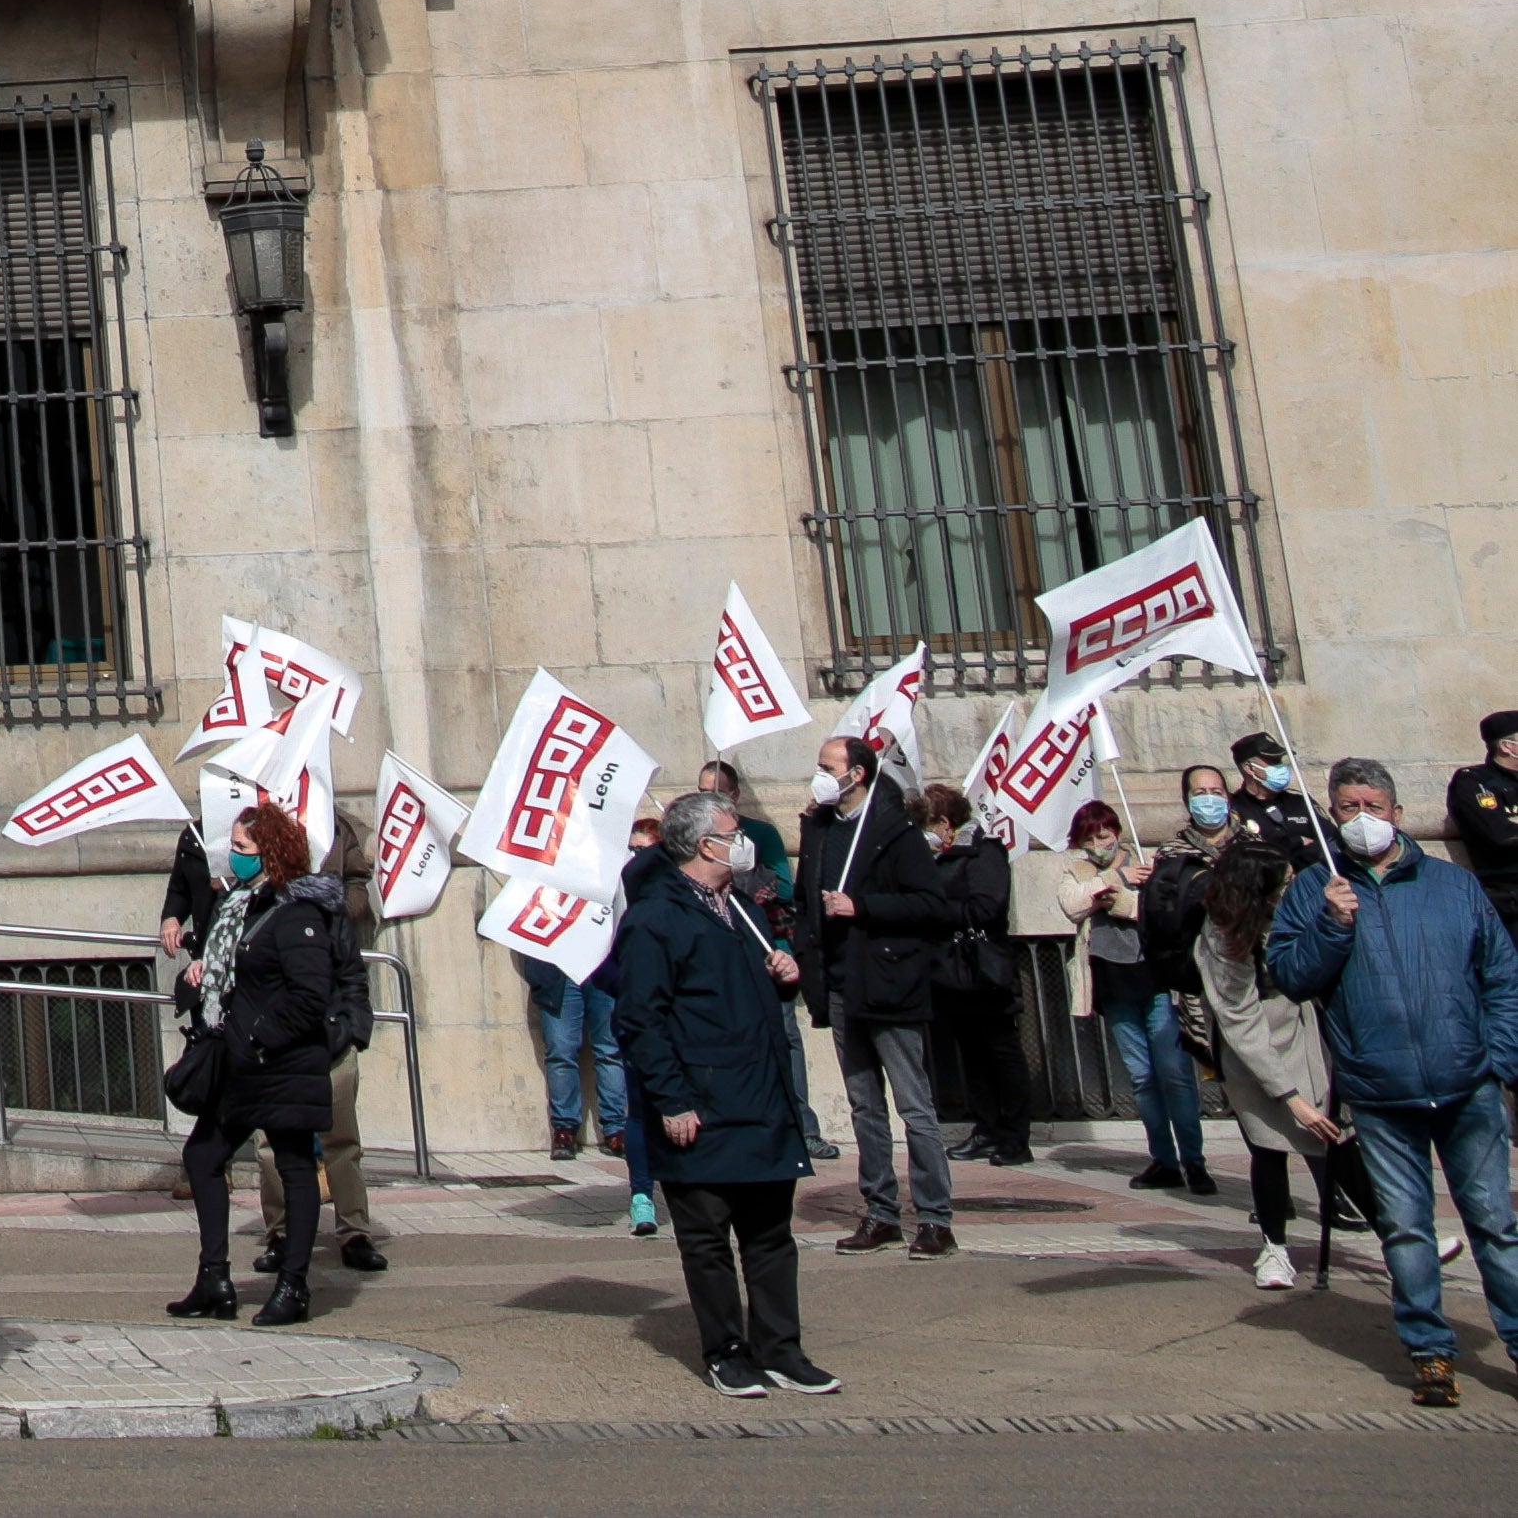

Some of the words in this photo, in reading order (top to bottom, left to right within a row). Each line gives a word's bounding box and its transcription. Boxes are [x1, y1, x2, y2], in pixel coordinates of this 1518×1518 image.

[1076, 574, 1208, 661] CCOO
[22, 763, 147, 831] CCOO
[511, 706, 603, 852] CCOO
[588, 762, 620, 811] León
[411, 841, 436, 878] León
